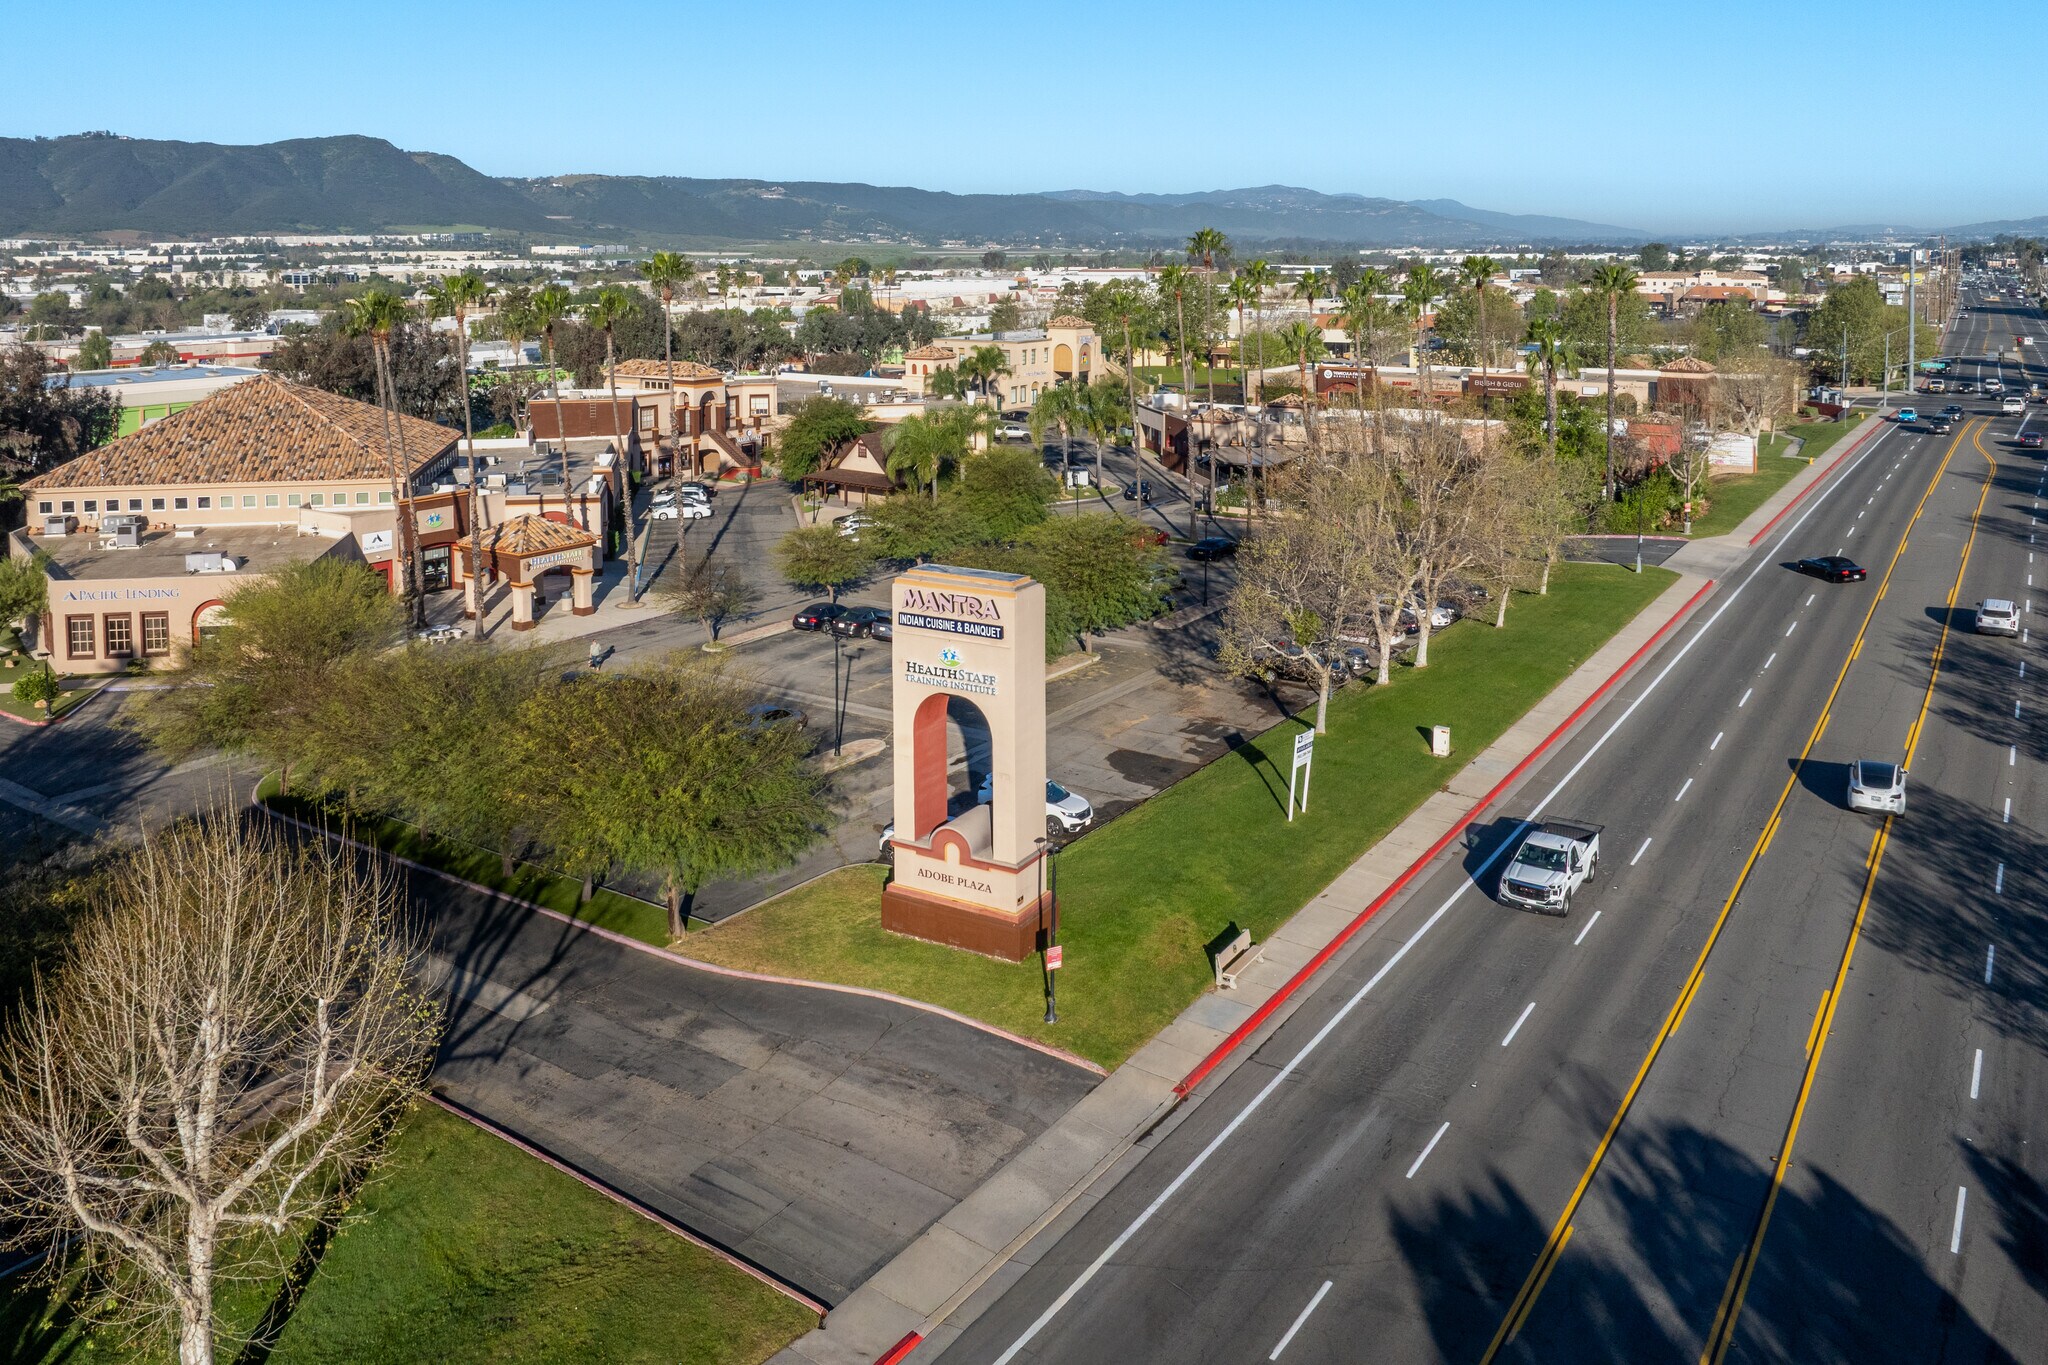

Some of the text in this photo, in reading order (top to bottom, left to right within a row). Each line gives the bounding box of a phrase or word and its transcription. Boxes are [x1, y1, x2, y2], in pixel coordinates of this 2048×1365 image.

[79, 588, 179, 600] PACIFIC LENDING
[902, 589, 1000, 620] MANTRA
[899, 613, 1001, 638] INDIAN CUISINE & BANQUET
[905, 674, 997, 696] TRAINING INSTITUTE
[906, 661, 996, 686] HEALTHSTAFF
[917, 868, 992, 893] ADOBE PLAZA
